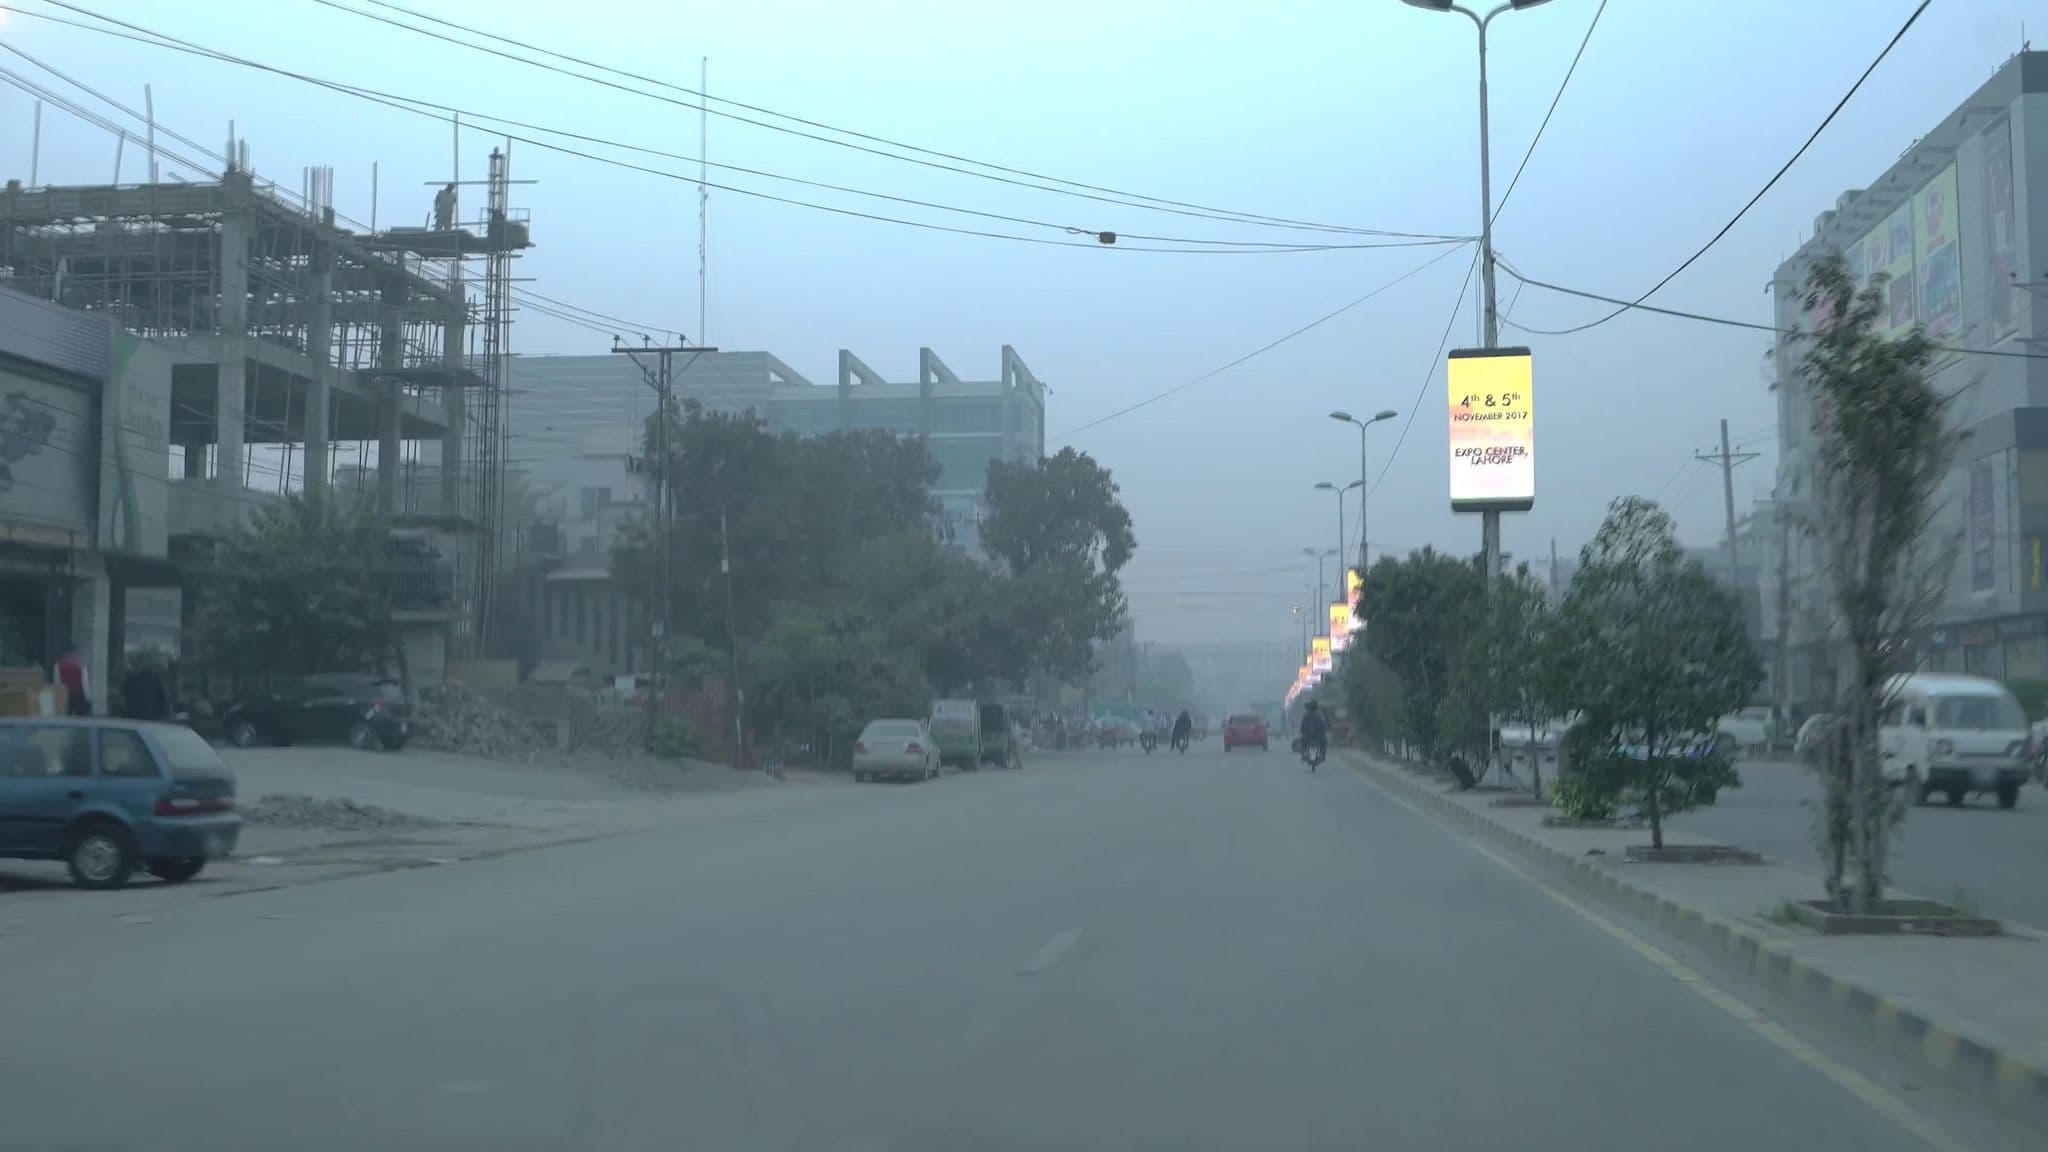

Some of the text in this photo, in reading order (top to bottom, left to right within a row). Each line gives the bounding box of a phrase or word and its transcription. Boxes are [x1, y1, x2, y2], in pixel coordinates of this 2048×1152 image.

[1461, 392, 1521, 408] 4th & 5th
[1454, 411, 1528, 421] NOVEMBER 2017
[1455, 446, 1528, 458] EXPO CENTER,
[1471, 455, 1513, 466] LAHORE
